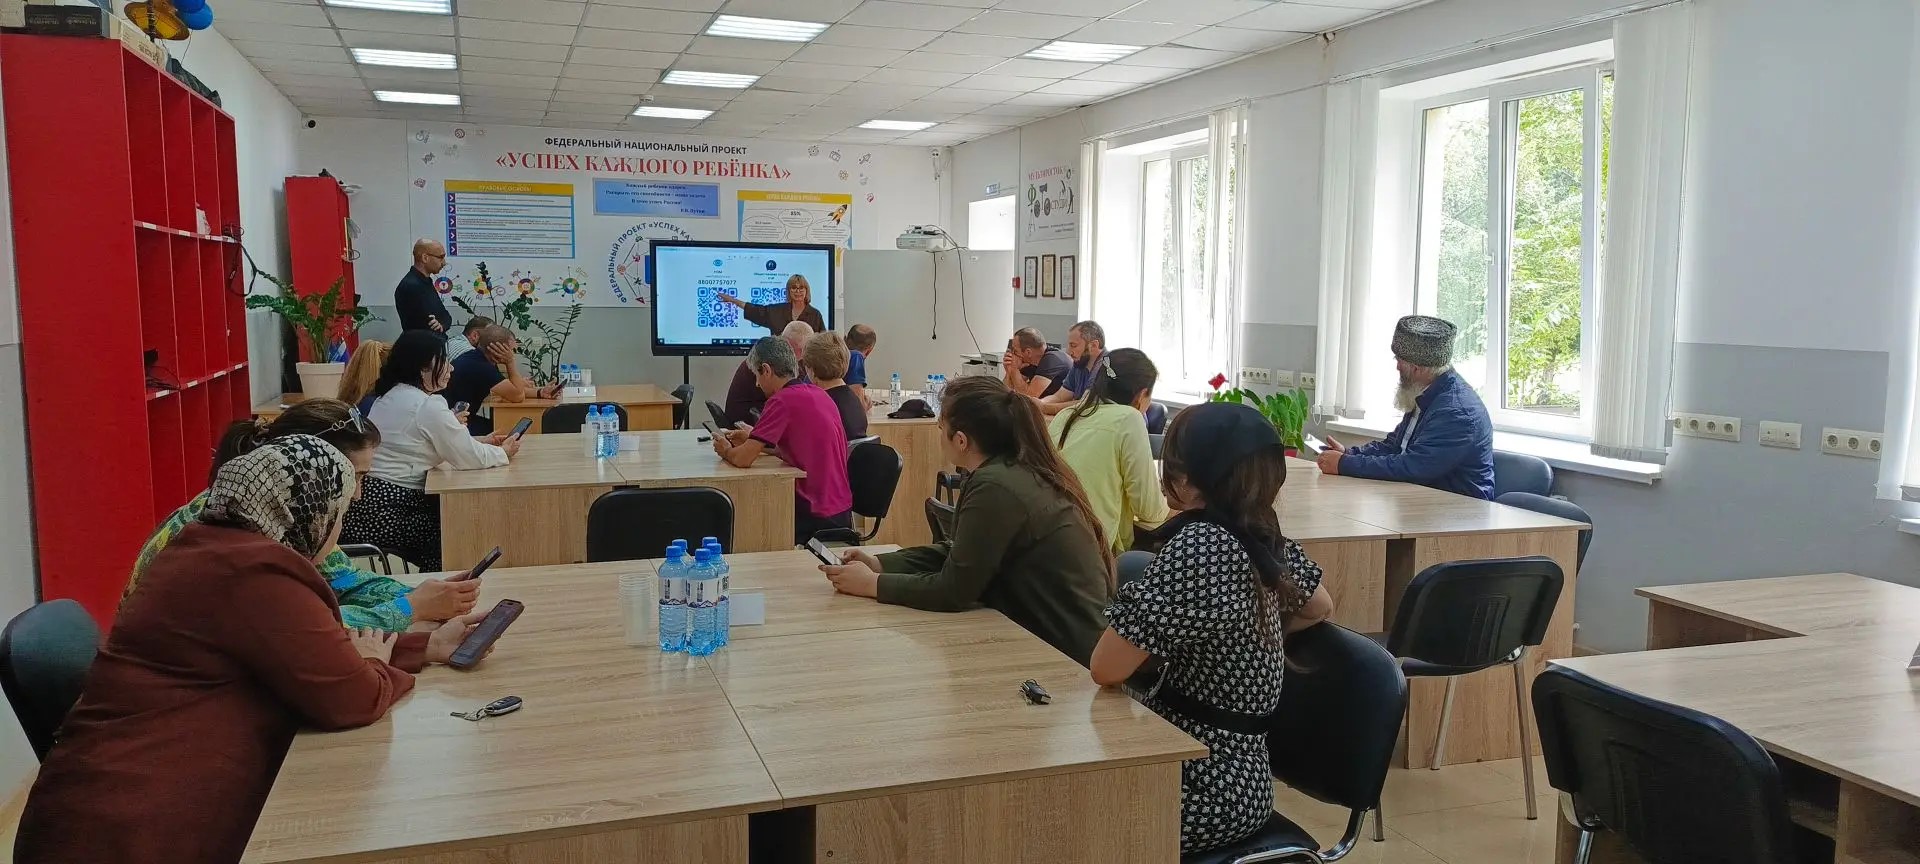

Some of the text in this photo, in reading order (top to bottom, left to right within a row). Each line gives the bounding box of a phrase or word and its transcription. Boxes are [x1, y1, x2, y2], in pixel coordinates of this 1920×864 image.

[544, 137, 748, 155] ФЕДЕРАЛЬНЫЙ НАЦИОНАЛЬНЫЙ ПРОЕКТ
[495, 152, 792, 179] «УСПЕХ КАЖДОГО РЕБЁНКА»
[607, 243, 627, 304] ФЕДЕРАЛЬНЫЙ
[617, 222, 647, 244] ПРОЕКТ
[648, 221, 680, 234] «УСПЕХ
